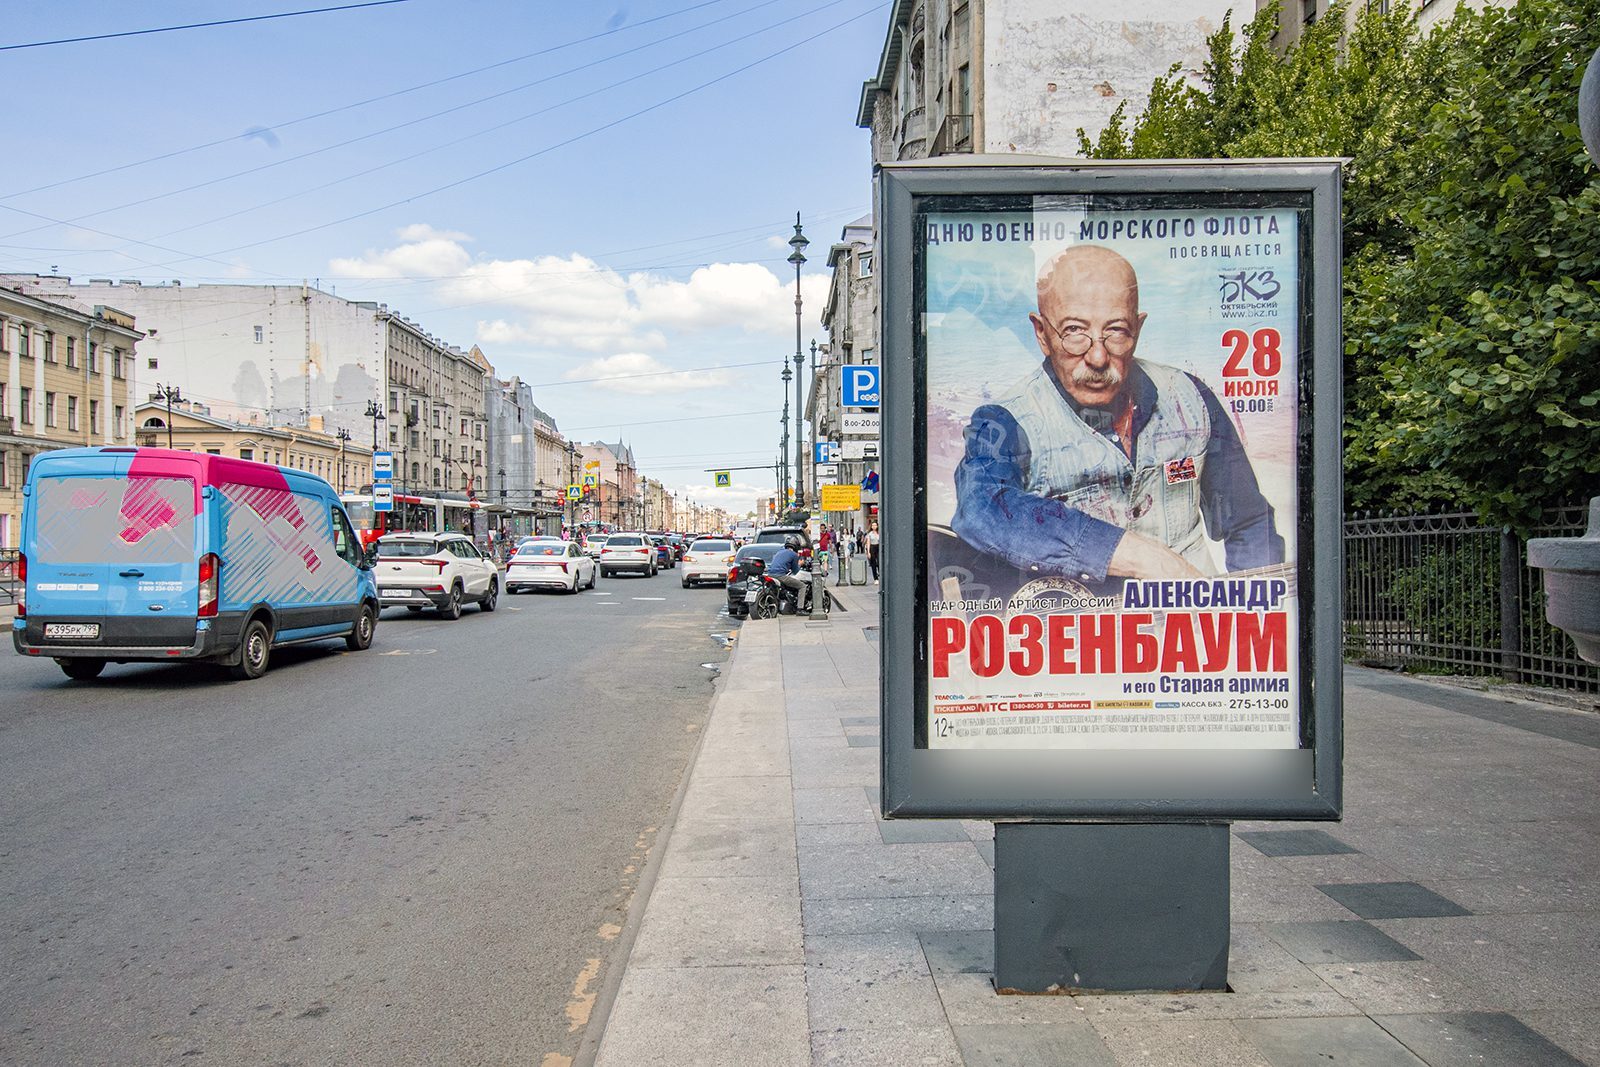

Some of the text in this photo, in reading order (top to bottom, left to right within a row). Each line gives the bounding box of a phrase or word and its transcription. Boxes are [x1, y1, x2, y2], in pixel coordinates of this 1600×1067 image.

[927, 223, 974, 245] ДНЮ
[1204, 215, 1280, 236] ФЛОТА
[1170, 243, 1281, 259] ПОСВЯЩАЕТСЯ
[1219, 270, 1281, 303] БКЗ
[1220, 301, 1278, 311] ОКТЯБРЬСКИЙ
[1221, 310, 1278, 319] www.bkz.ru
[1221, 327, 1282, 378] 28
[1224, 379, 1279, 397] ИЮЛЯ
[1230, 398, 1266, 413] 19.00
[931, 598, 1114, 611] НАРОДНЫЙ АРТИСТ РОССИИ
[1124, 579, 1287, 611] АЛЕКСАНДР
[931, 612, 1288, 678] РОЗЕНБАУМ
[1123, 675, 1289, 695] и его Старая армия
[1229, 698, 1289, 709] 275-13-00
[934, 717, 954, 738] 12+
